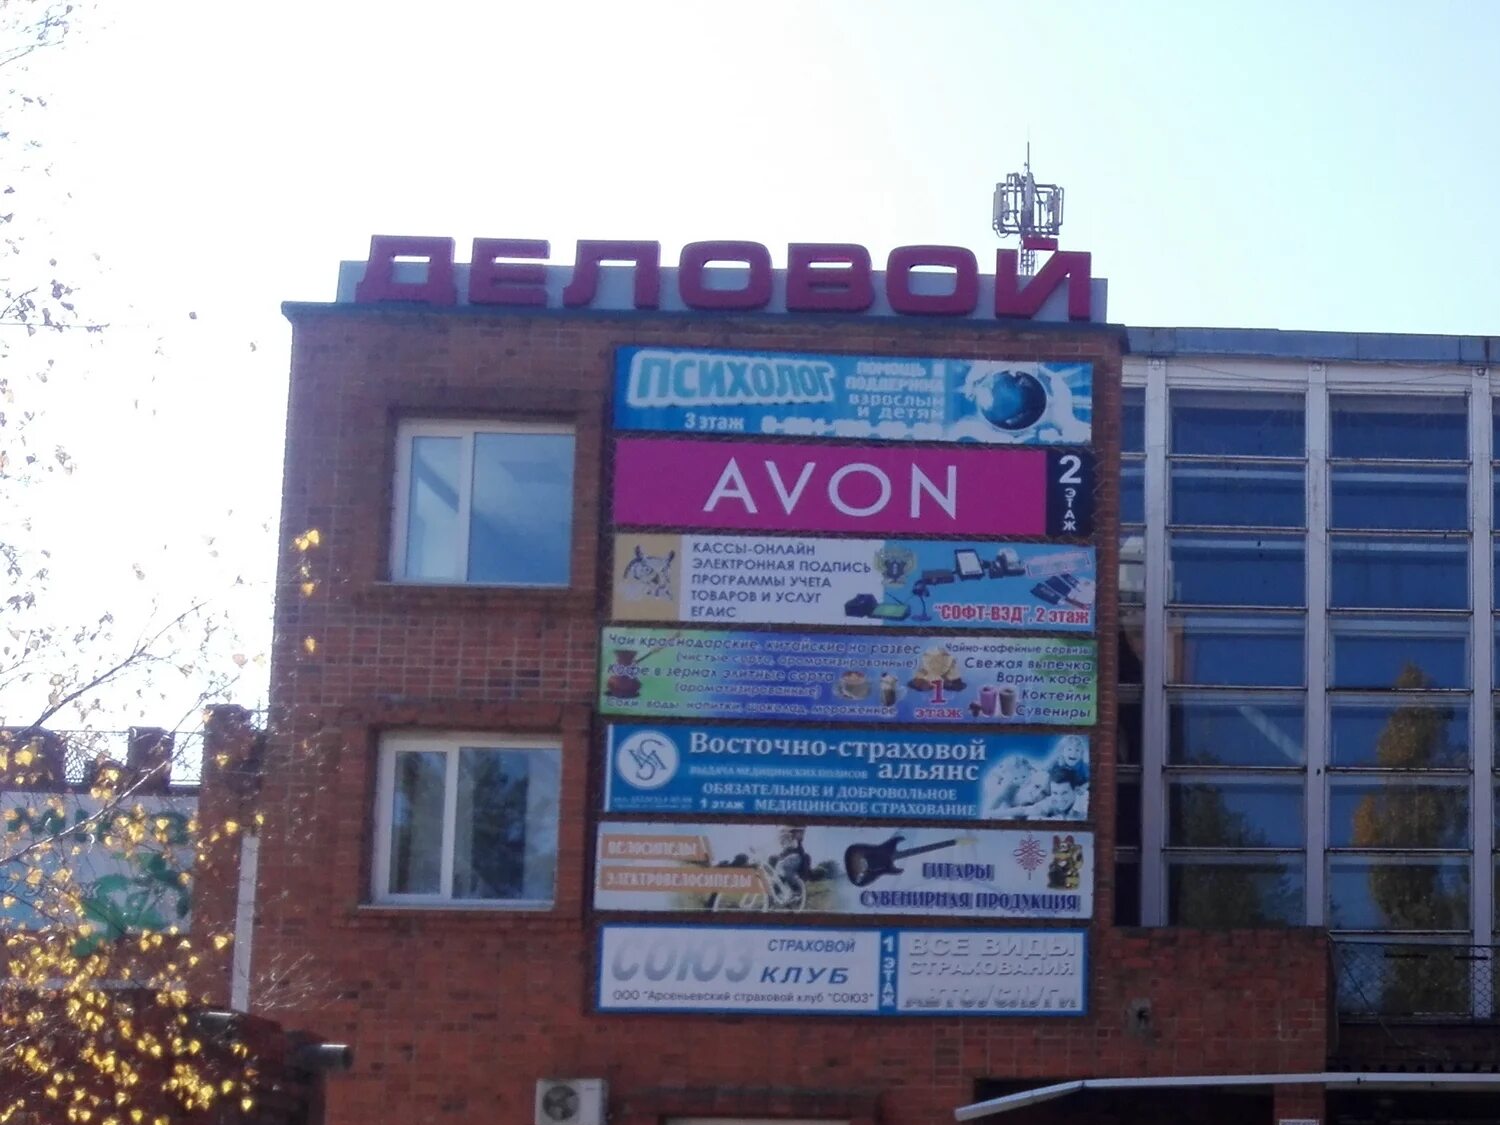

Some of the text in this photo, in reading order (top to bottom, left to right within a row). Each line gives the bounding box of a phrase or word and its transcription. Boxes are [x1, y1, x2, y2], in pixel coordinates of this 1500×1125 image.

[355, 234, 1092, 320] ДЕЛОВОЙ
[632, 353, 834, 402] ПСИХОЛОГ
[684, 411, 696, 430] 3
[699, 415, 745, 431] этаж
[1059, 455, 1082, 484] 2
[703, 456, 958, 520] AVON
[1062, 487, 1077, 531] ЭТАЖ
[693, 542, 816, 556] КАССЫ-ОНЛАЙН
[692, 558, 872, 574] ЭЛЕКТРОННАЯ ПОДПИСЬ
[692, 574, 832, 588] ПРОГРАММЫ УЧЕТА
[691, 590, 822, 604] ТОВАРОВ И УСЛУГ
[691, 606, 737, 618] ЕГАИС
[1036, 607, 1045, 623] 2
[1048, 610, 1089, 624] этаж
[965, 657, 1091, 671] Свежая выпечка
[997, 672, 1091, 687] Варим кофе
[930, 679, 946, 703] 1
[1022, 688, 1091, 701] Коктейли
[915, 707, 962, 719] этаж
[1016, 705, 1090, 719] Сувениры
[690, 732, 986, 764] Восточно-страховой
[878, 763, 979, 781] альянс
[703, 783, 957, 800] ОБЯЗАТЕЛЬНОЕ И ДОБРОВОЛЬНОЕ
[700, 798, 707, 809] 1
[755, 799, 977, 815] МЕДИЦИНСКОЕ СТРАХОВАНИЕ
[922, 862, 994, 881] ГИТАРЫ
[860, 890, 1080, 912] СУВЕНИРНАЯ ПРОДУКЦИЯ
[768, 939, 856, 953] СТРАХОВОЙ
[883, 936, 894, 952] 1
[909, 937, 1076, 960] ВСЕ ВИДЫ
[611, 935, 753, 983] СОЮЗ
[760, 966, 849, 984] КЛУБ
[909, 962, 1076, 976] СТРАХОВАНИЯ
[883, 957, 895, 1006] ЭТАЖ
[613, 991, 640, 1000] ООО
[734, 991, 794, 1003] страховой
[797, 992, 823, 1003] клуб
